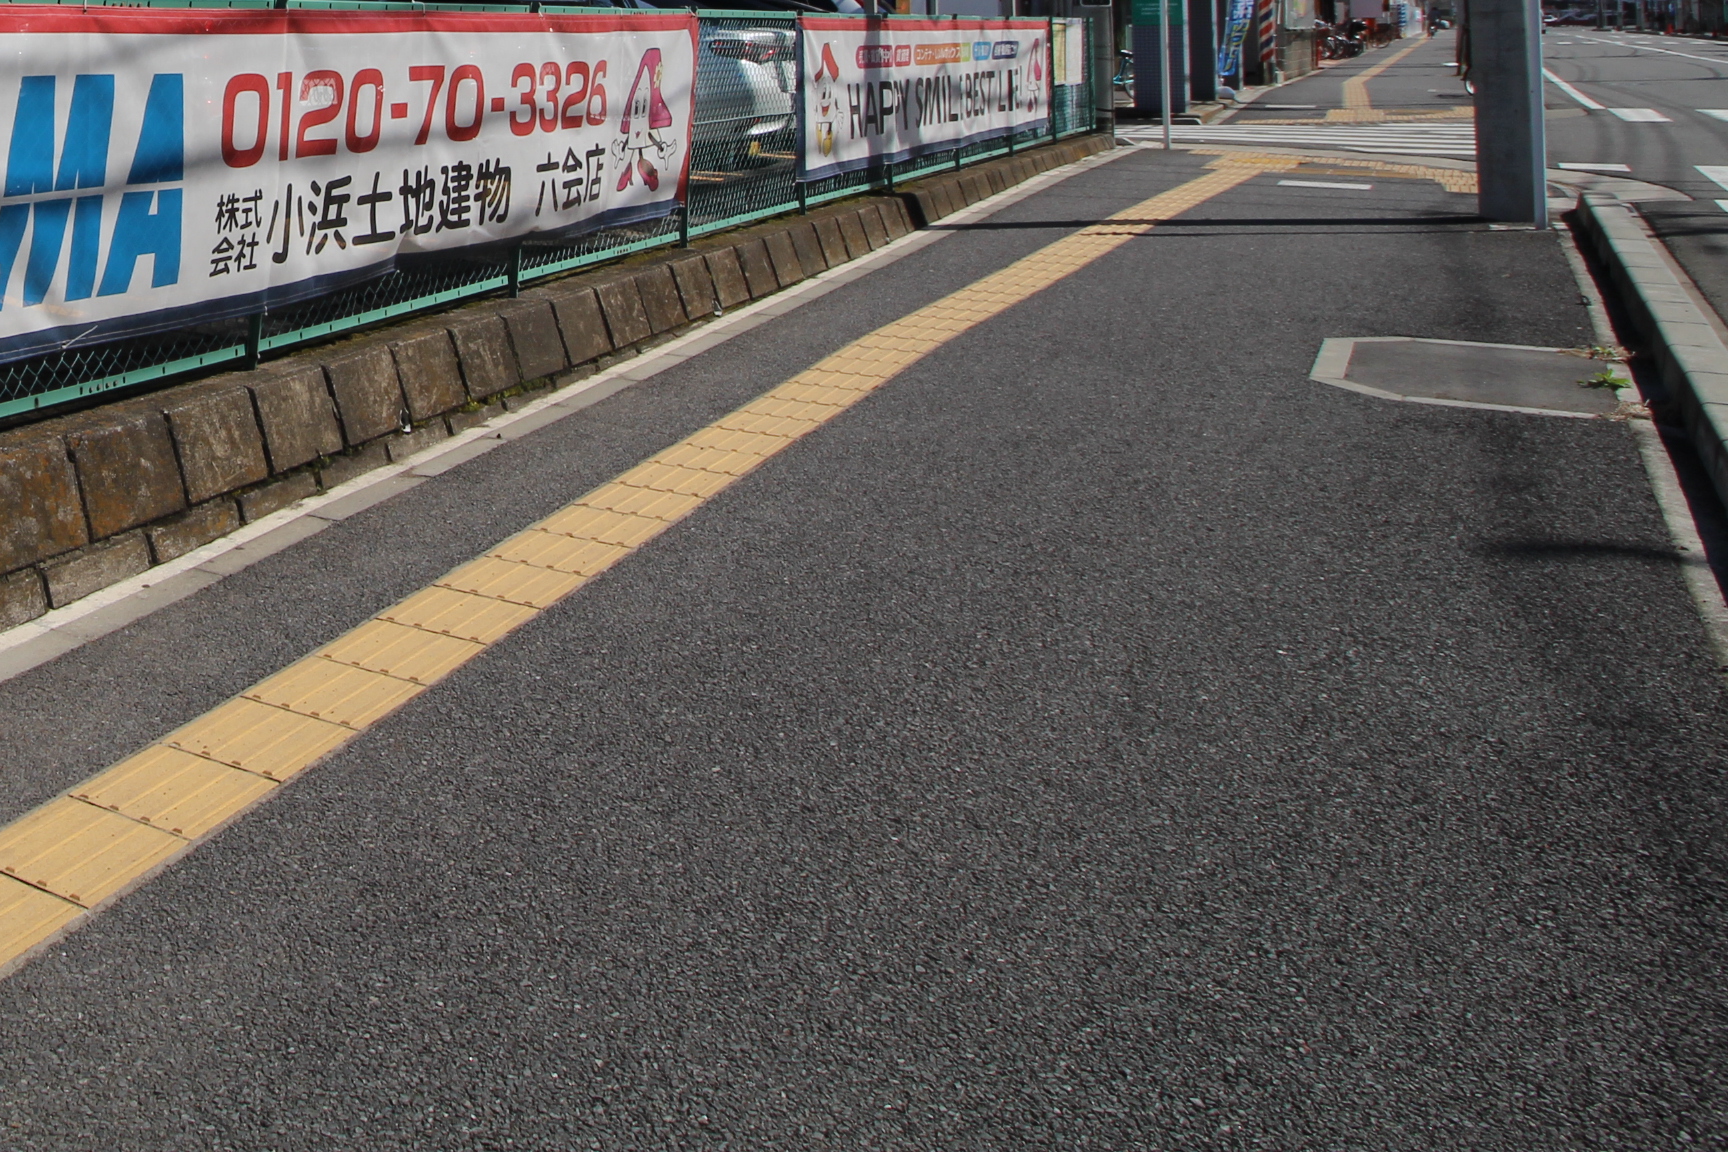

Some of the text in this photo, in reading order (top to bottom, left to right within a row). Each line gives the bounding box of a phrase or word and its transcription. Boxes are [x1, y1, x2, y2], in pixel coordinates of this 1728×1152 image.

[221, 59, 608, 169] 0120-70-3326
[847, 77, 910, 140] HAPPY
[965, 70, 995, 119] BEST
[215, 188, 264, 233] 株式
[266, 142, 606, 264] 小浜土地建物 六会店
[208, 232, 260, 278] 会社
